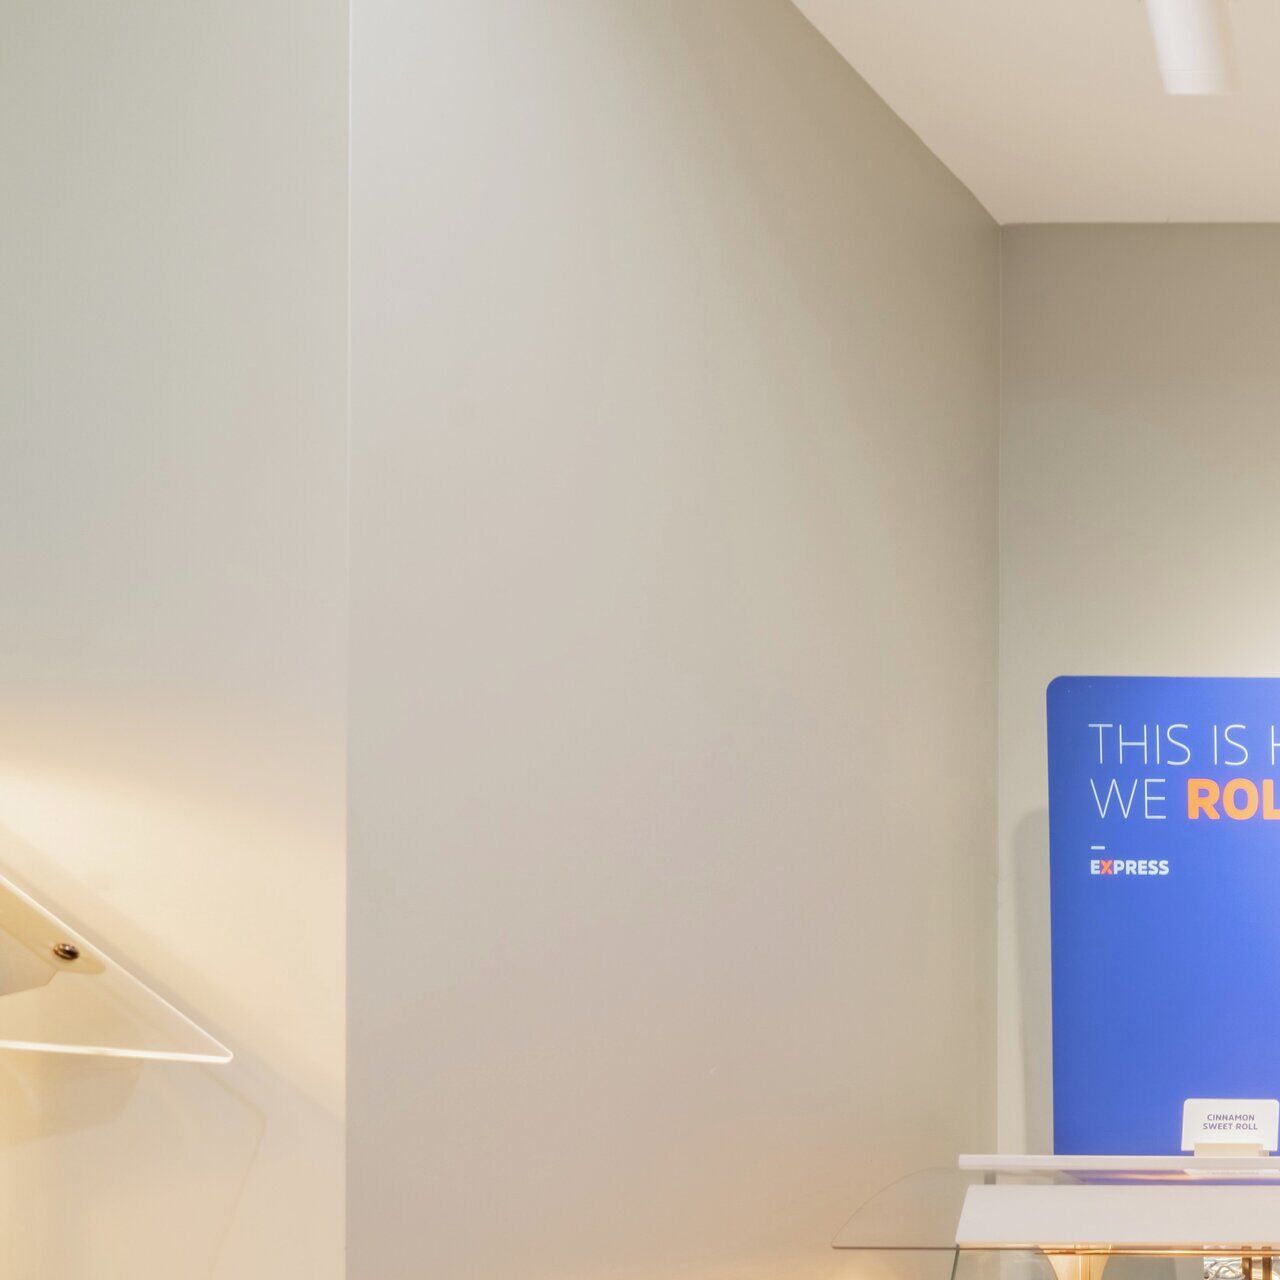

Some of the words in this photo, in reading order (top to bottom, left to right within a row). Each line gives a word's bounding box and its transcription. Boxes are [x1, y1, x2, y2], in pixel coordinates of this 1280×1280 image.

[1088, 723, 1191, 766] THIS
[1214, 724, 1249, 766] IS
[1090, 778, 1166, 820] WE
[1090, 860, 1170, 876] EXPRESS
